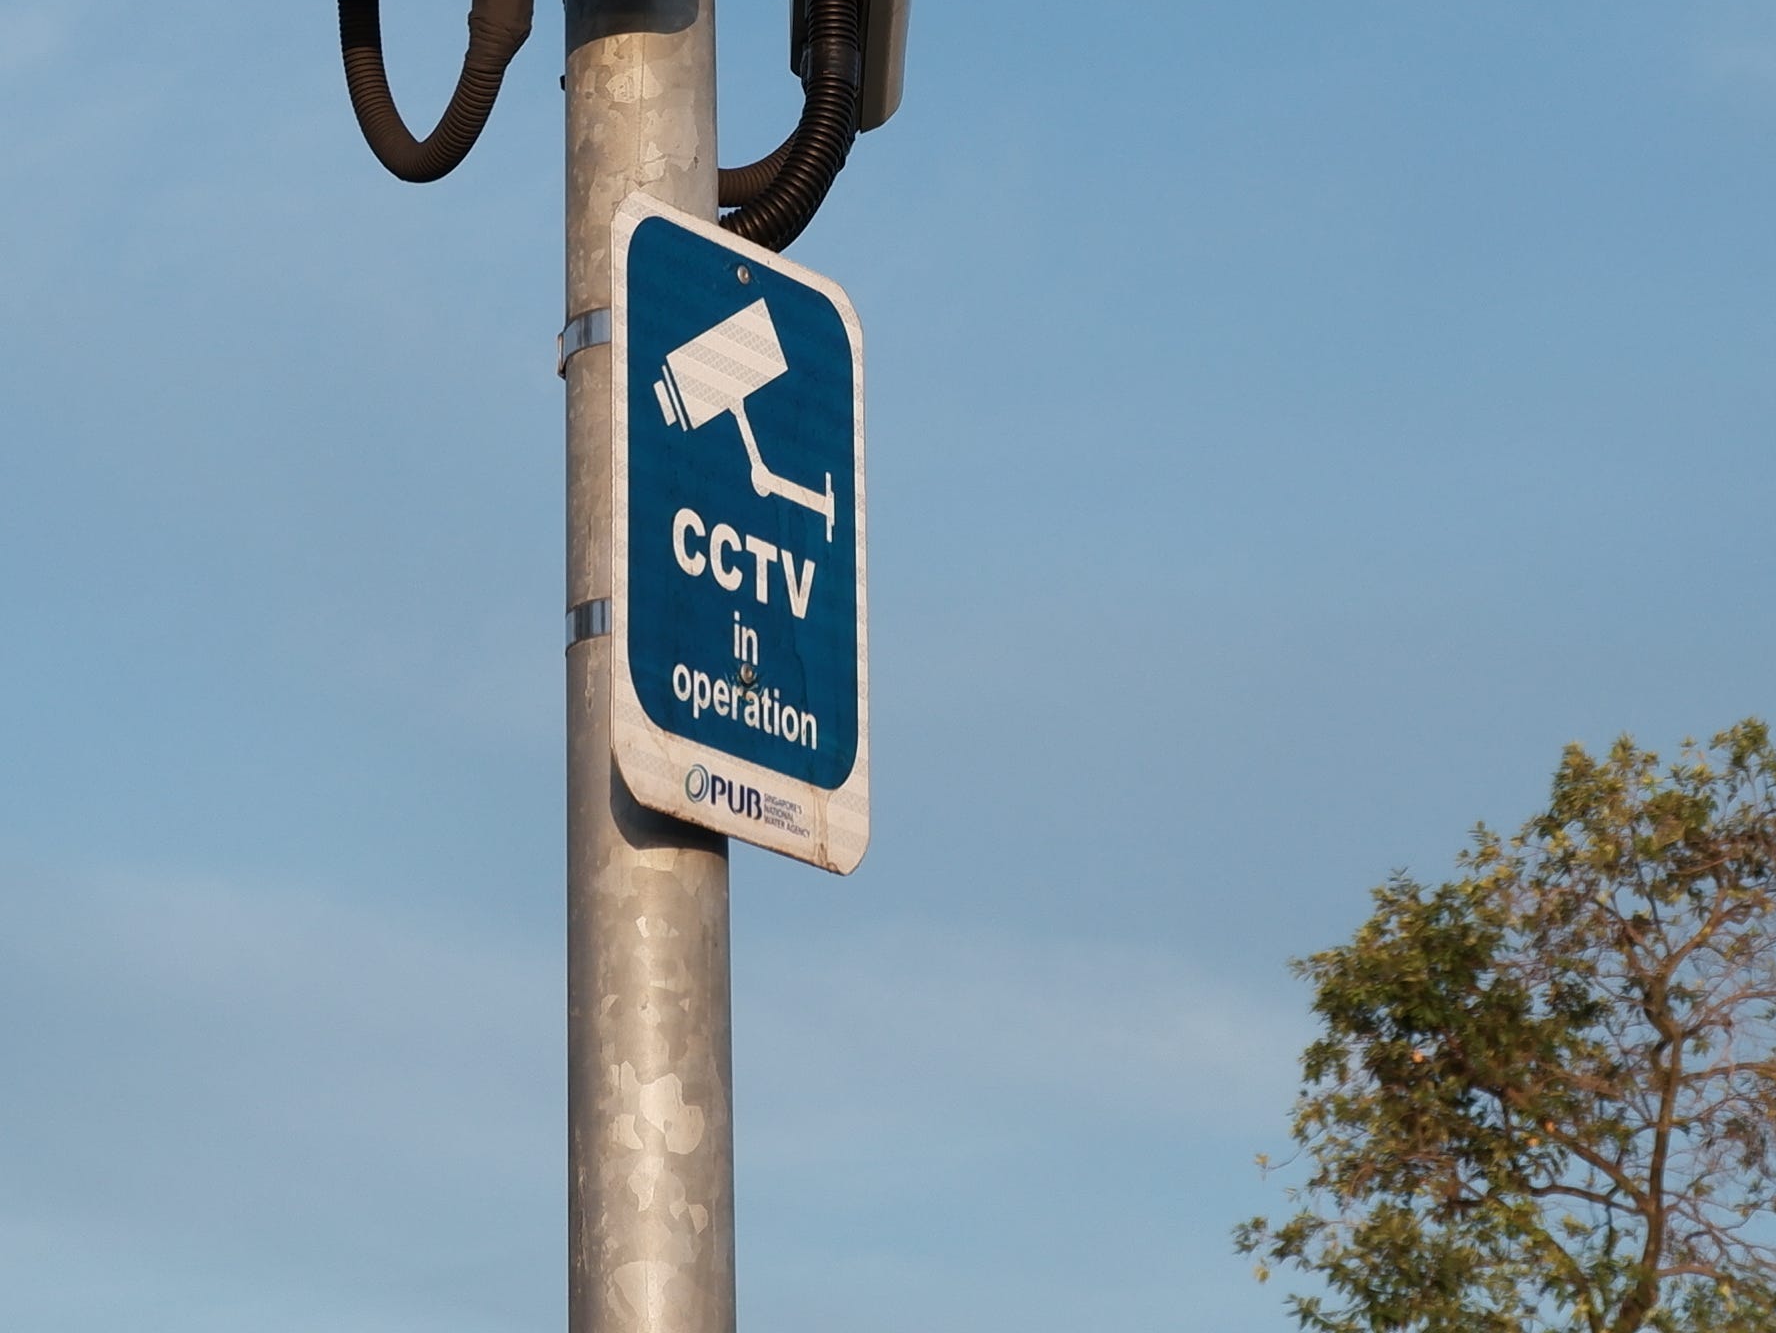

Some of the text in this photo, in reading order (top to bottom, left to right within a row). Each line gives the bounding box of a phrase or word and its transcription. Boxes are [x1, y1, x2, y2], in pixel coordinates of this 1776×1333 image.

[673, 508, 816, 619] CCTV
[734, 610, 758, 665] in
[673, 664, 817, 750] operation
[710, 774, 762, 820] PUB
[764, 803, 794, 823] NATIONAL
[764, 815, 811, 839] WATER AGENCY
